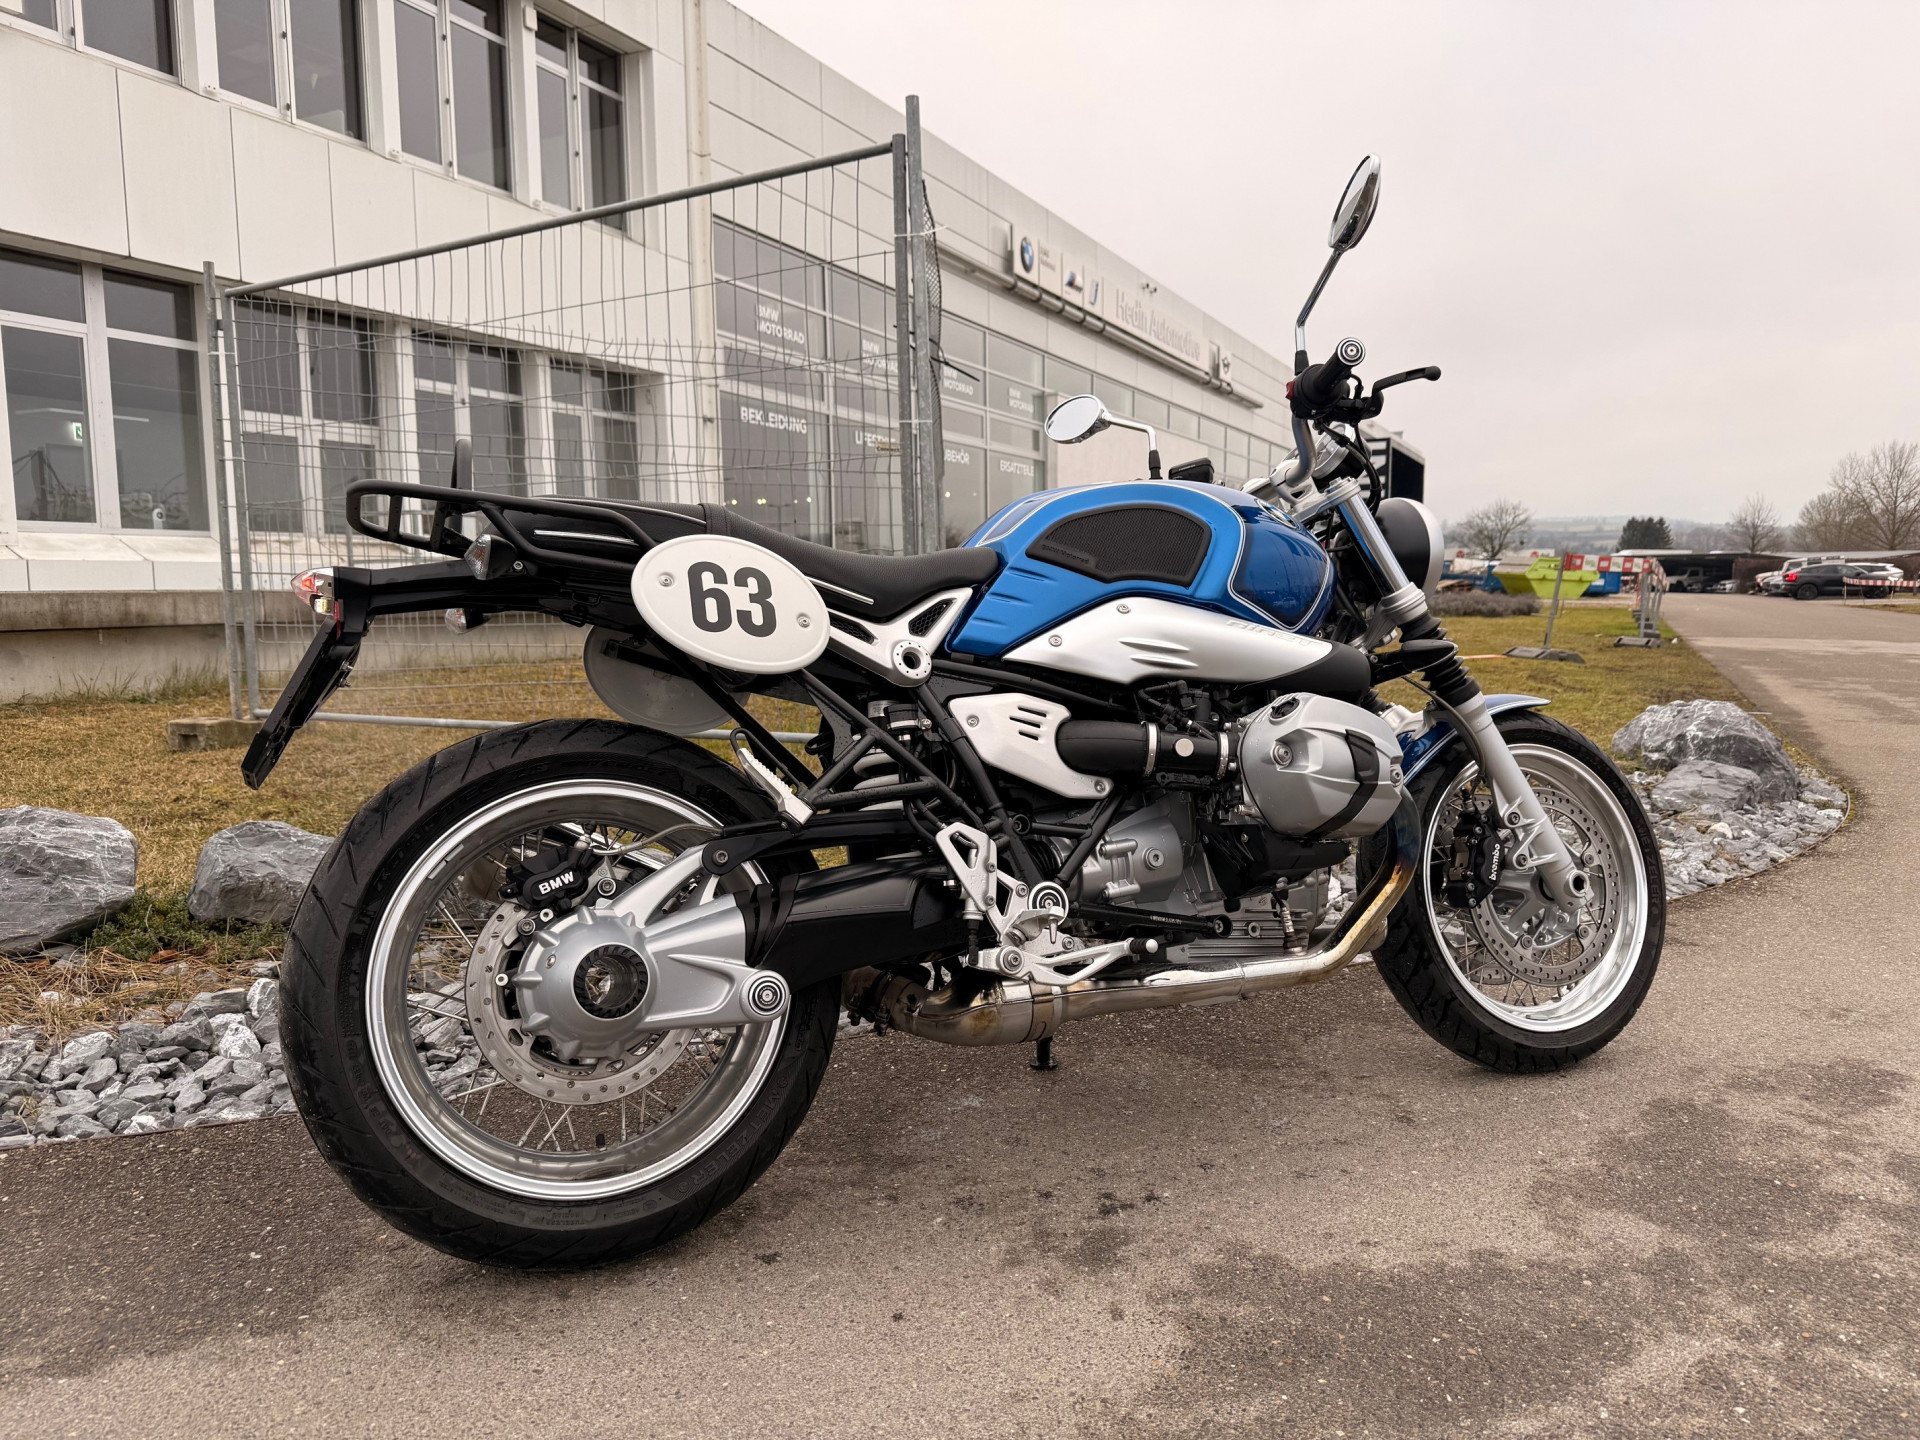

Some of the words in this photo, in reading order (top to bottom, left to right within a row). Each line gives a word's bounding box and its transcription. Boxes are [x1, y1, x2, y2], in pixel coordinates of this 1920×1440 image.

[756, 303, 779, 322] BMW
[756, 319, 805, 344] MOTORRAD
[740, 406, 807, 434] BEKLEIDUNG
[687, 560, 777, 638] 63
[1488, 843, 1501, 881] brembo
[538, 871, 574, 895] BMW
[690, 1089, 781, 1185] METZELER
